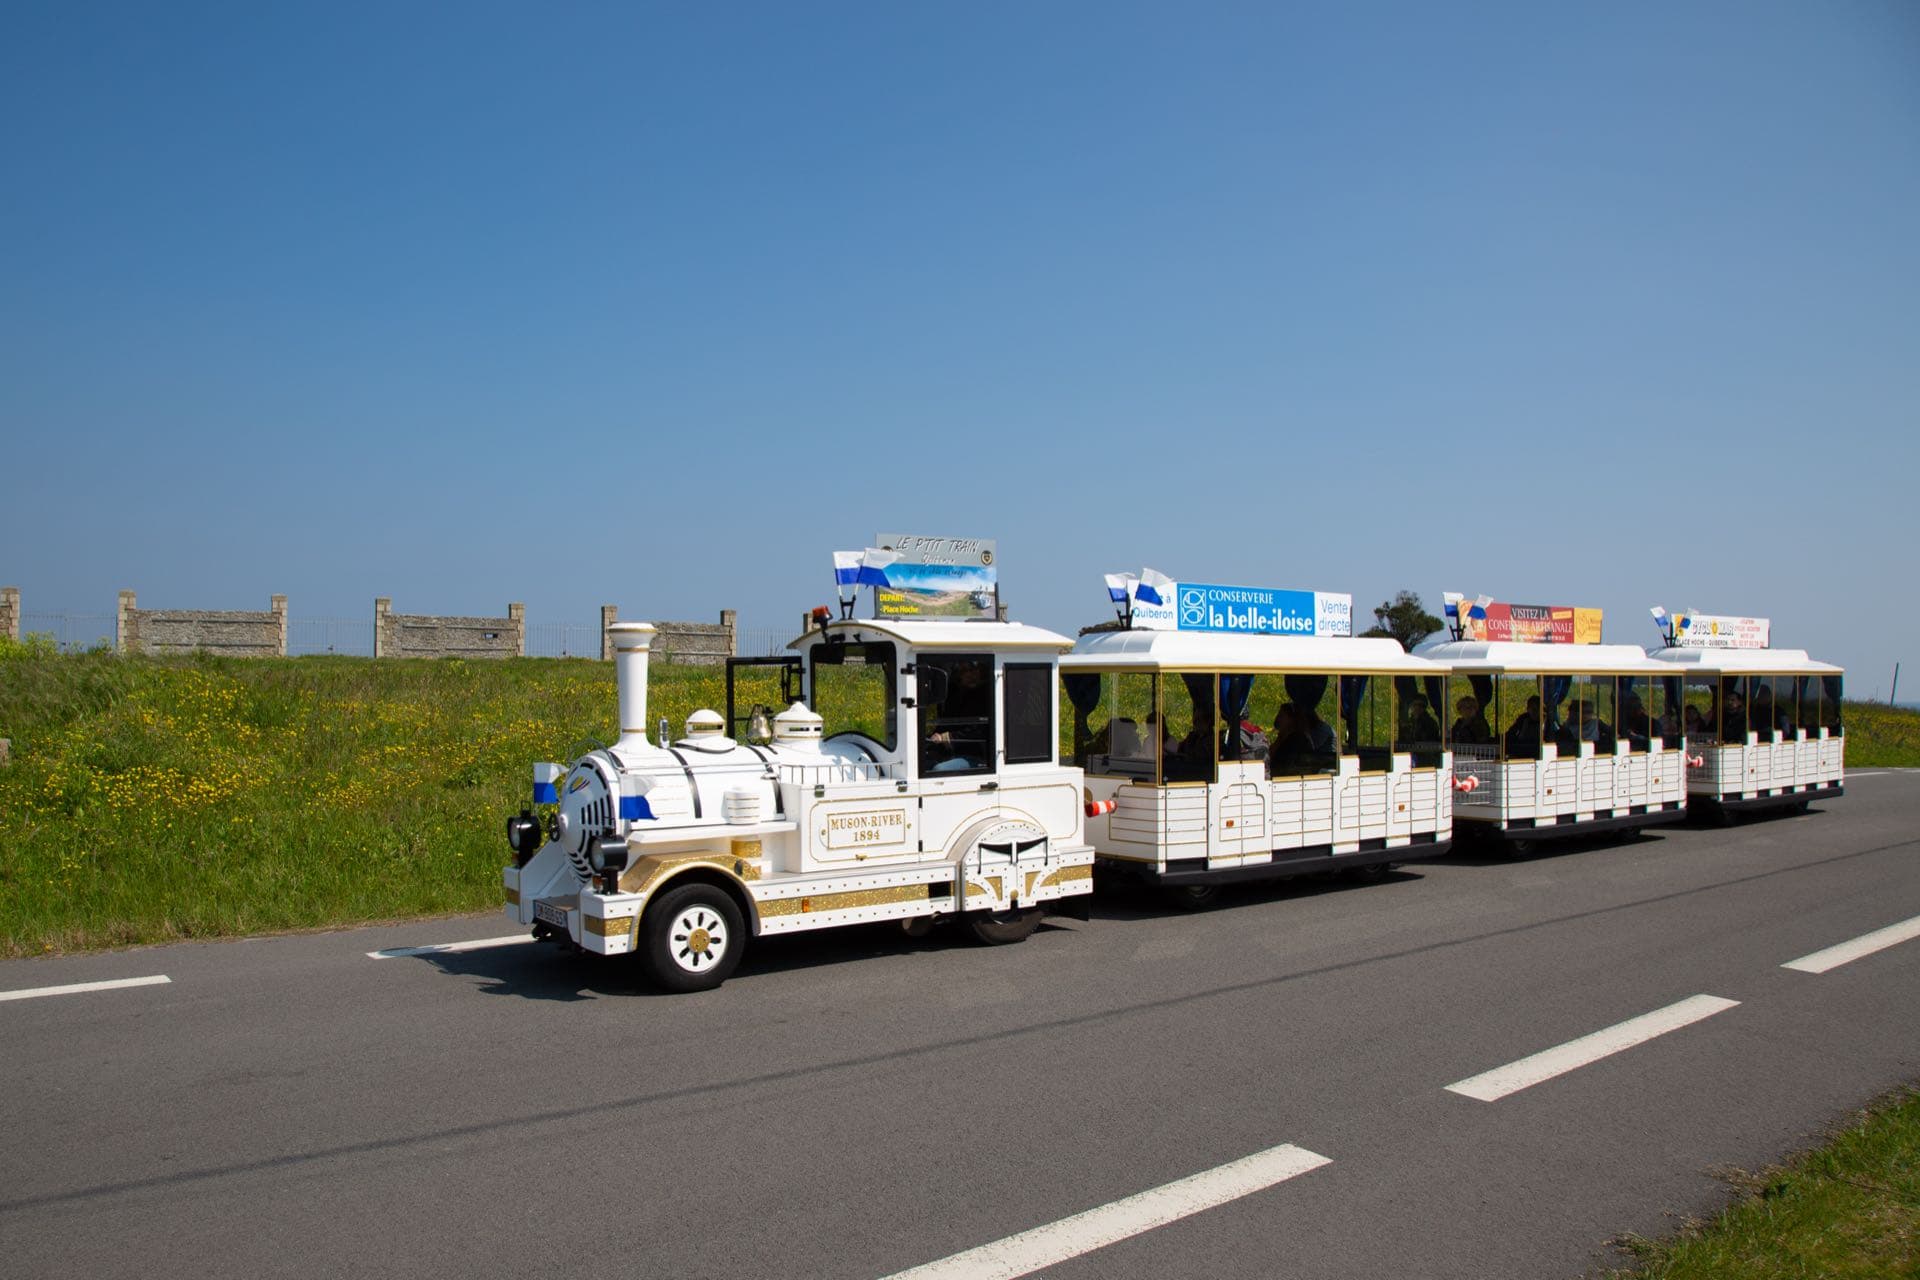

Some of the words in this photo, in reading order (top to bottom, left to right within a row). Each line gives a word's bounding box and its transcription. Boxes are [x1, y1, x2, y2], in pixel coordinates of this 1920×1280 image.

[896, 537, 911, 551] LE
[949, 539, 979, 554] TRAIN
[1208, 589, 1274, 604] CONSERVERIE
[1133, 607, 1174, 619] Quiberon
[1321, 599, 1349, 614] Vente
[1209, 605, 1224, 628] la
[1228, 606, 1313, 631] belle-iloise
[1511, 607, 1538, 620] VISITEZ
[1540, 608, 1549, 621] LA
[1319, 619, 1351, 632] directe
[1531, 621, 1573, 634] ARTISANALE
[854, 830, 880, 842] 1894
